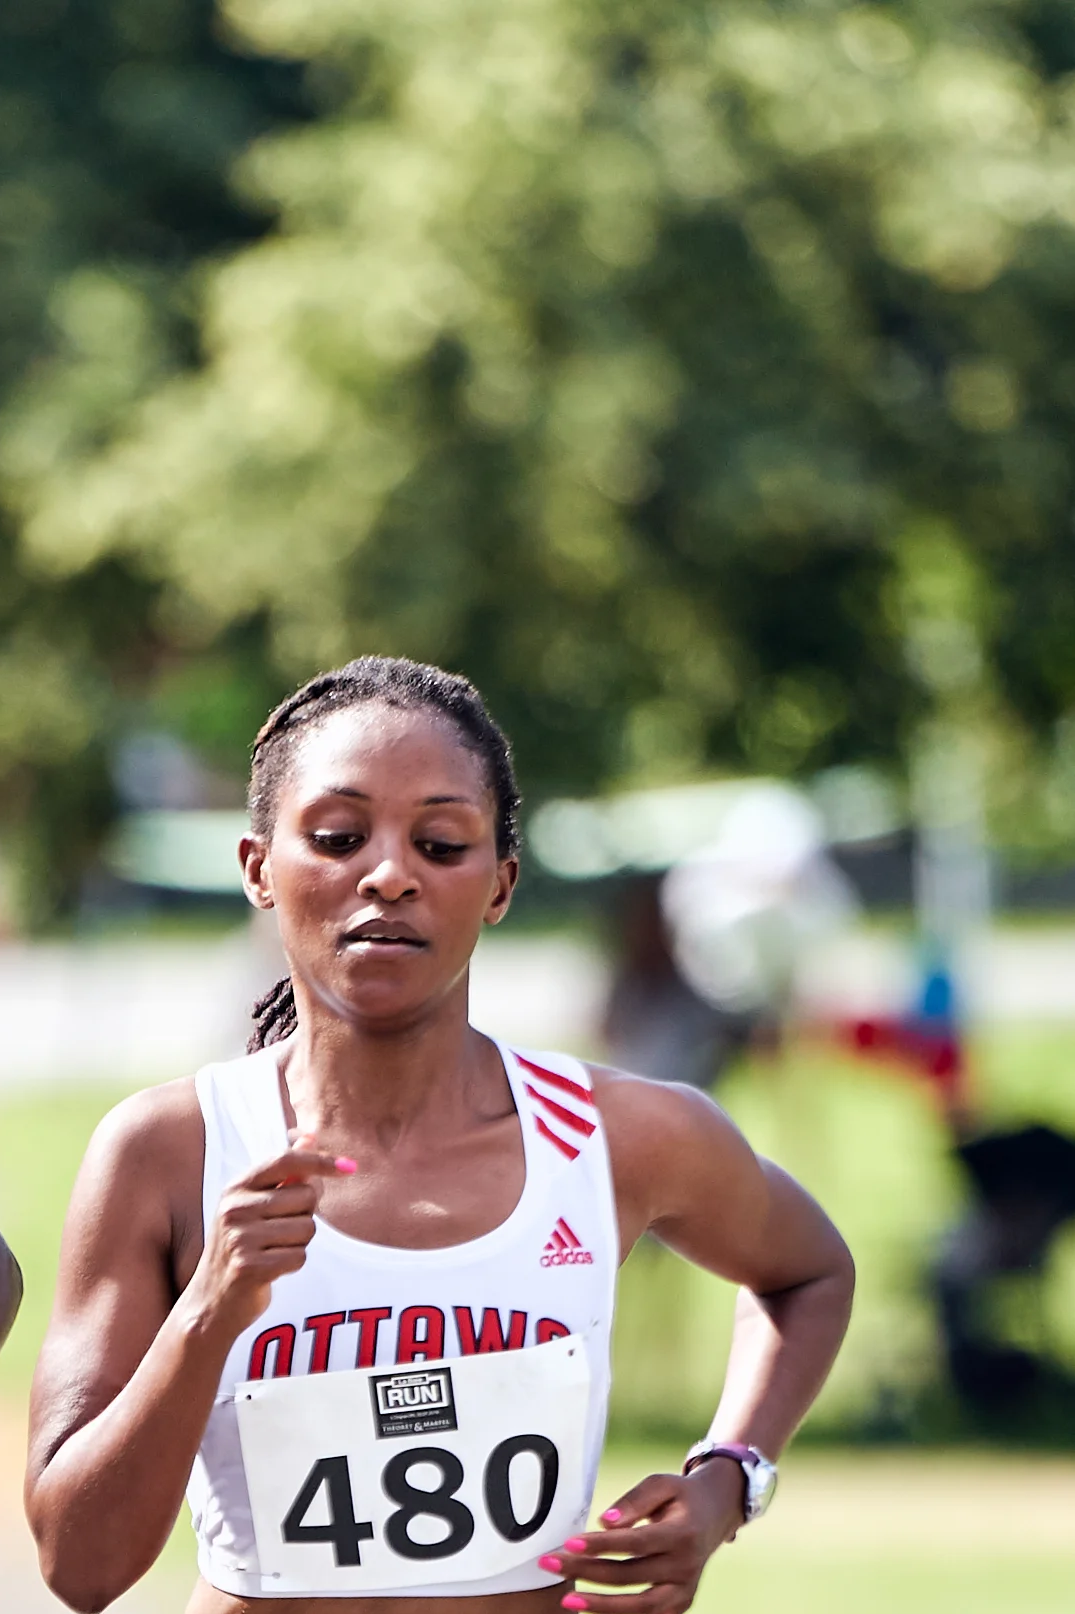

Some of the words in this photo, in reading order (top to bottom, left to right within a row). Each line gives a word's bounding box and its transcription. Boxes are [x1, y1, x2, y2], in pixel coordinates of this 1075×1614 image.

[539, 1247, 593, 1267] adidas
[387, 1384, 438, 1407] RUN
[414, 1421, 424, 1432] &
[281, 1434, 560, 1568] 480
